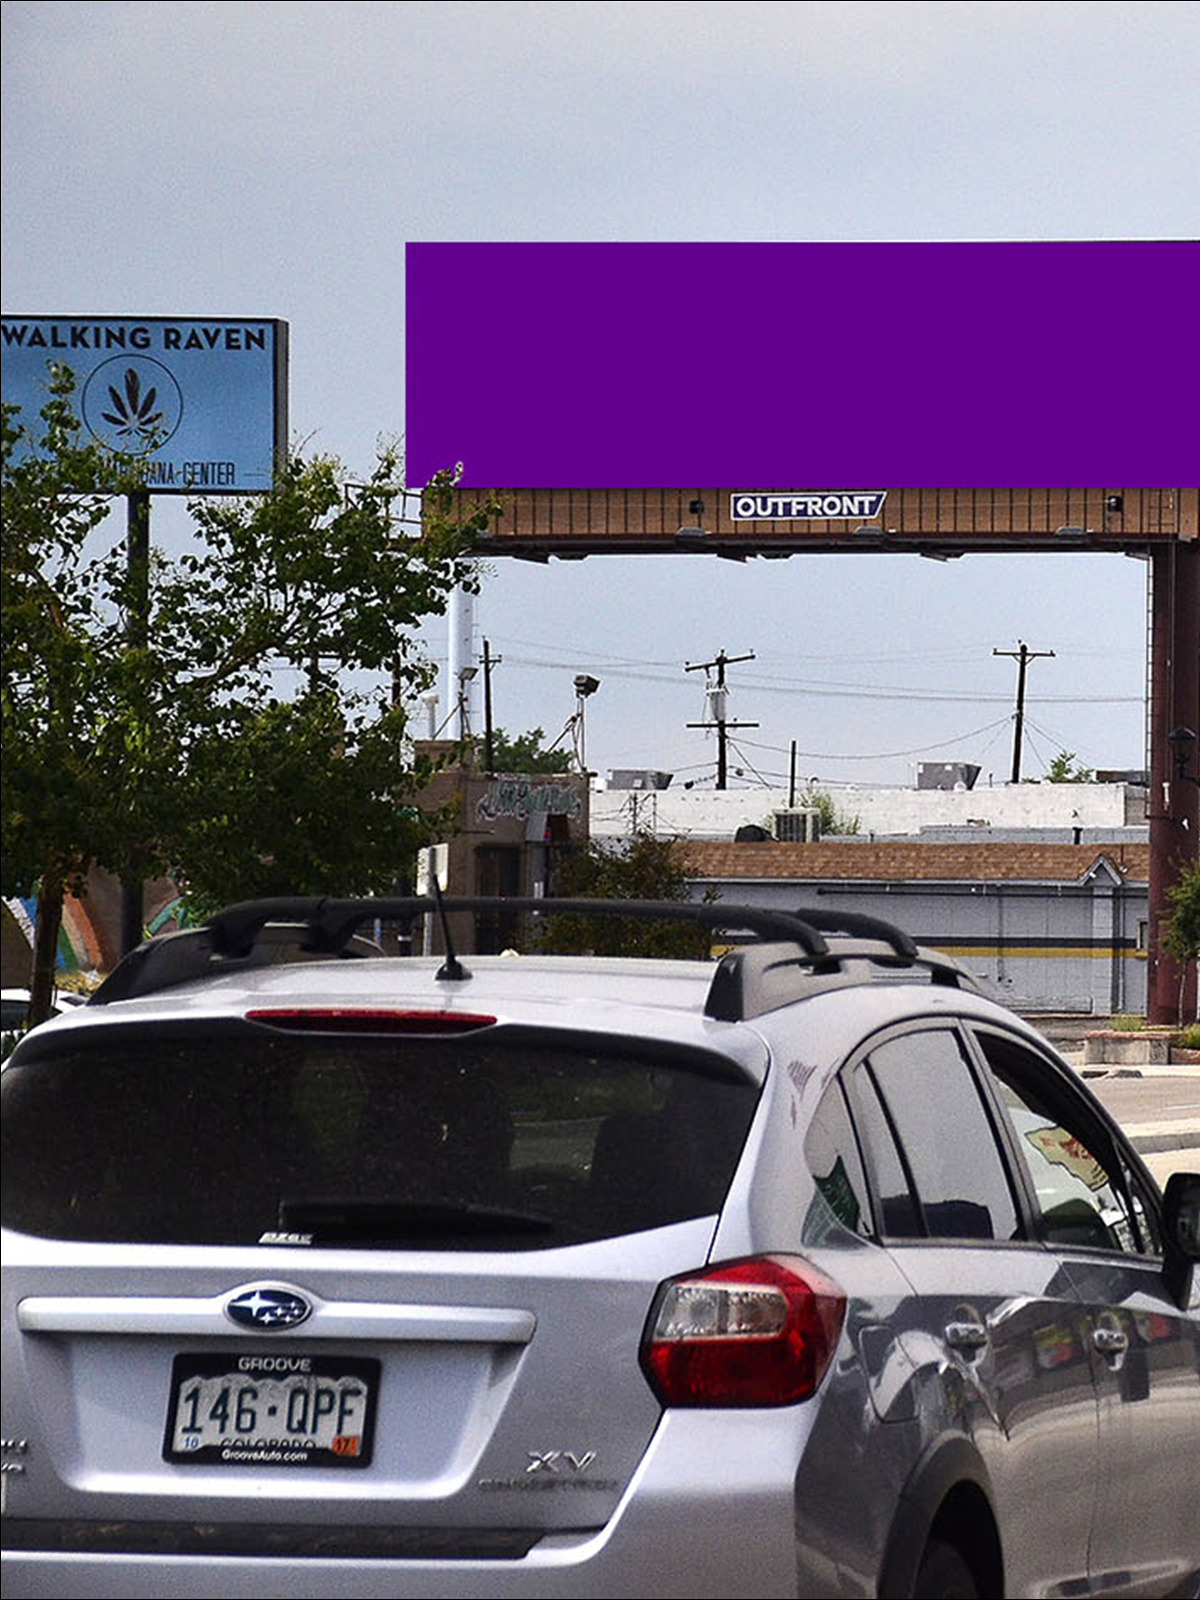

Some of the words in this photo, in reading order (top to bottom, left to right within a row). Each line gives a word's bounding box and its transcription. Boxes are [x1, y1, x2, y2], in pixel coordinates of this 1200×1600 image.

[1, 324, 150, 348] WALKING
[164, 328, 265, 350] RAVEN
[182, 461, 235, 486] CENTER
[736, 495, 877, 516] OUTFRONT
[238, 1356, 312, 1372] GROOVE
[221, 1448, 308, 1462] GrooveAuto.com
[525, 1451, 597, 1473] XV
